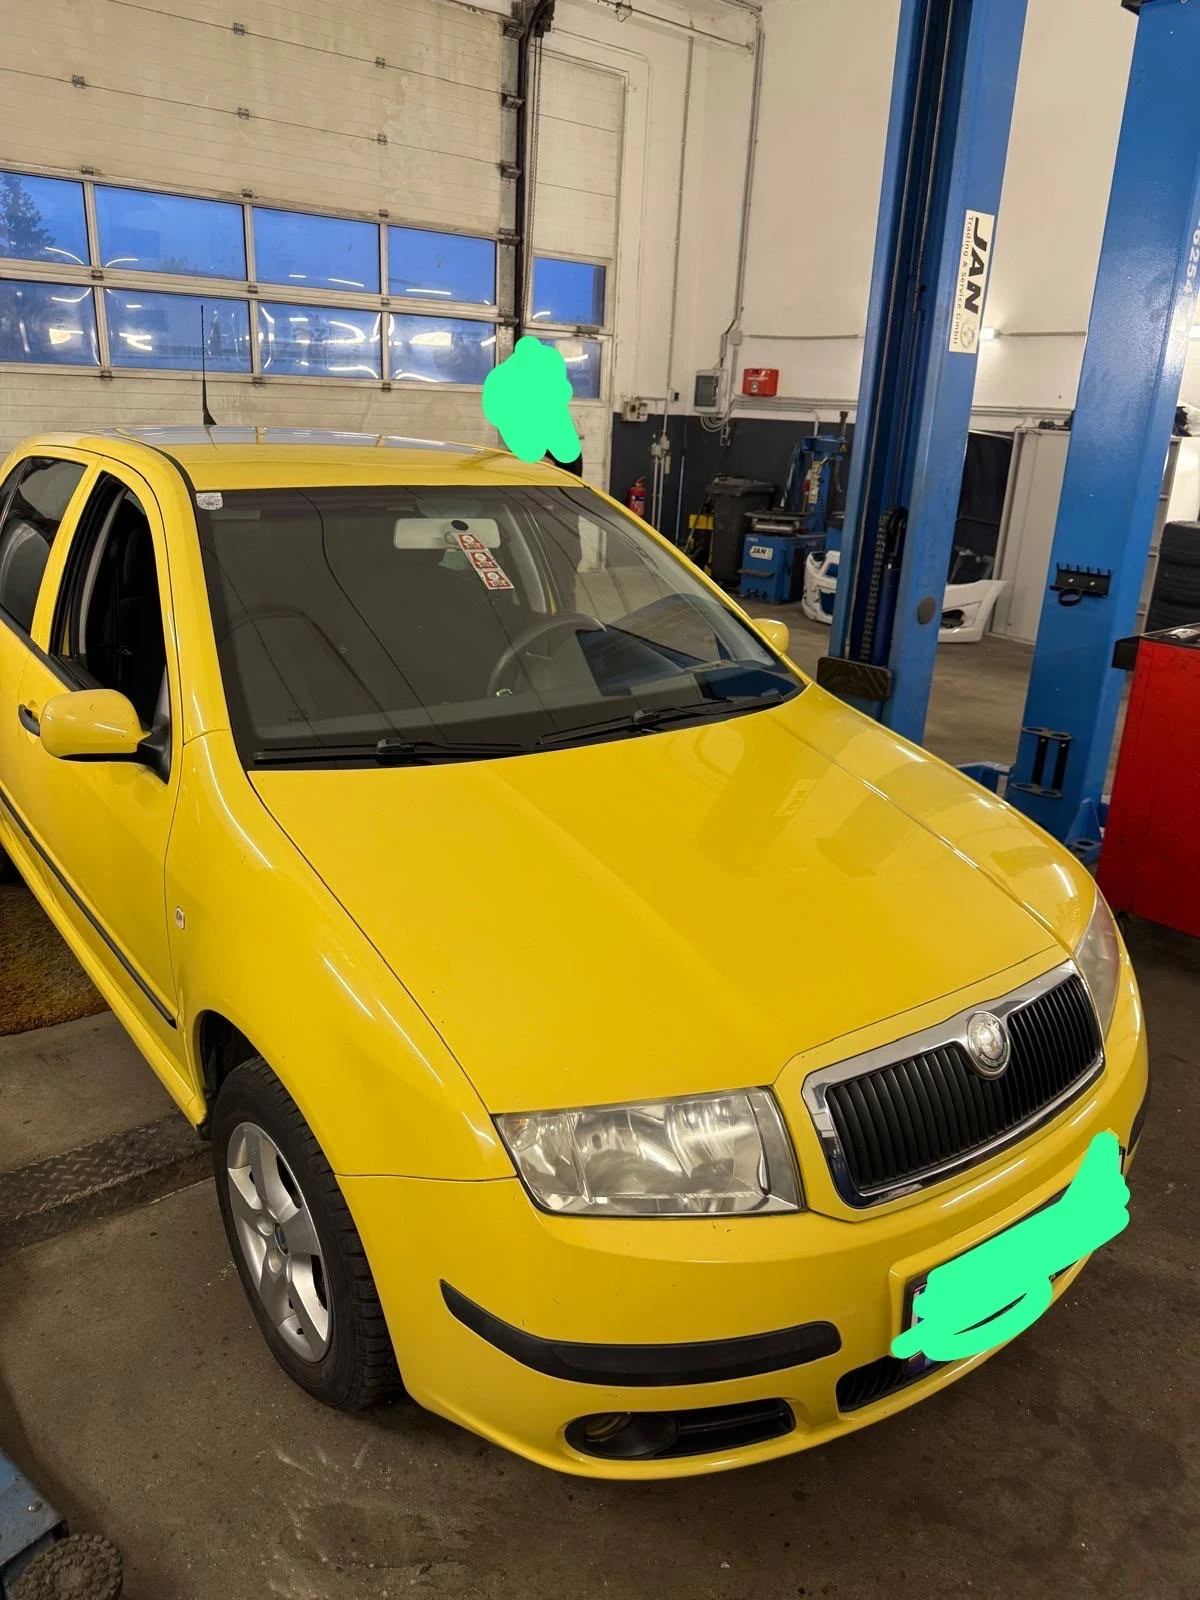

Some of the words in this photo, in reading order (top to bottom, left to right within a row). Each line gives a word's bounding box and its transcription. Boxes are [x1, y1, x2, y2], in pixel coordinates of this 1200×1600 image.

[963, 215, 974, 257] Trading
[961, 260, 968, 268] &
[964, 217, 988, 315] JAN
[957, 271, 967, 309] Service
[953, 313, 962, 344] GmbH
[751, 547, 767, 555] JAN
